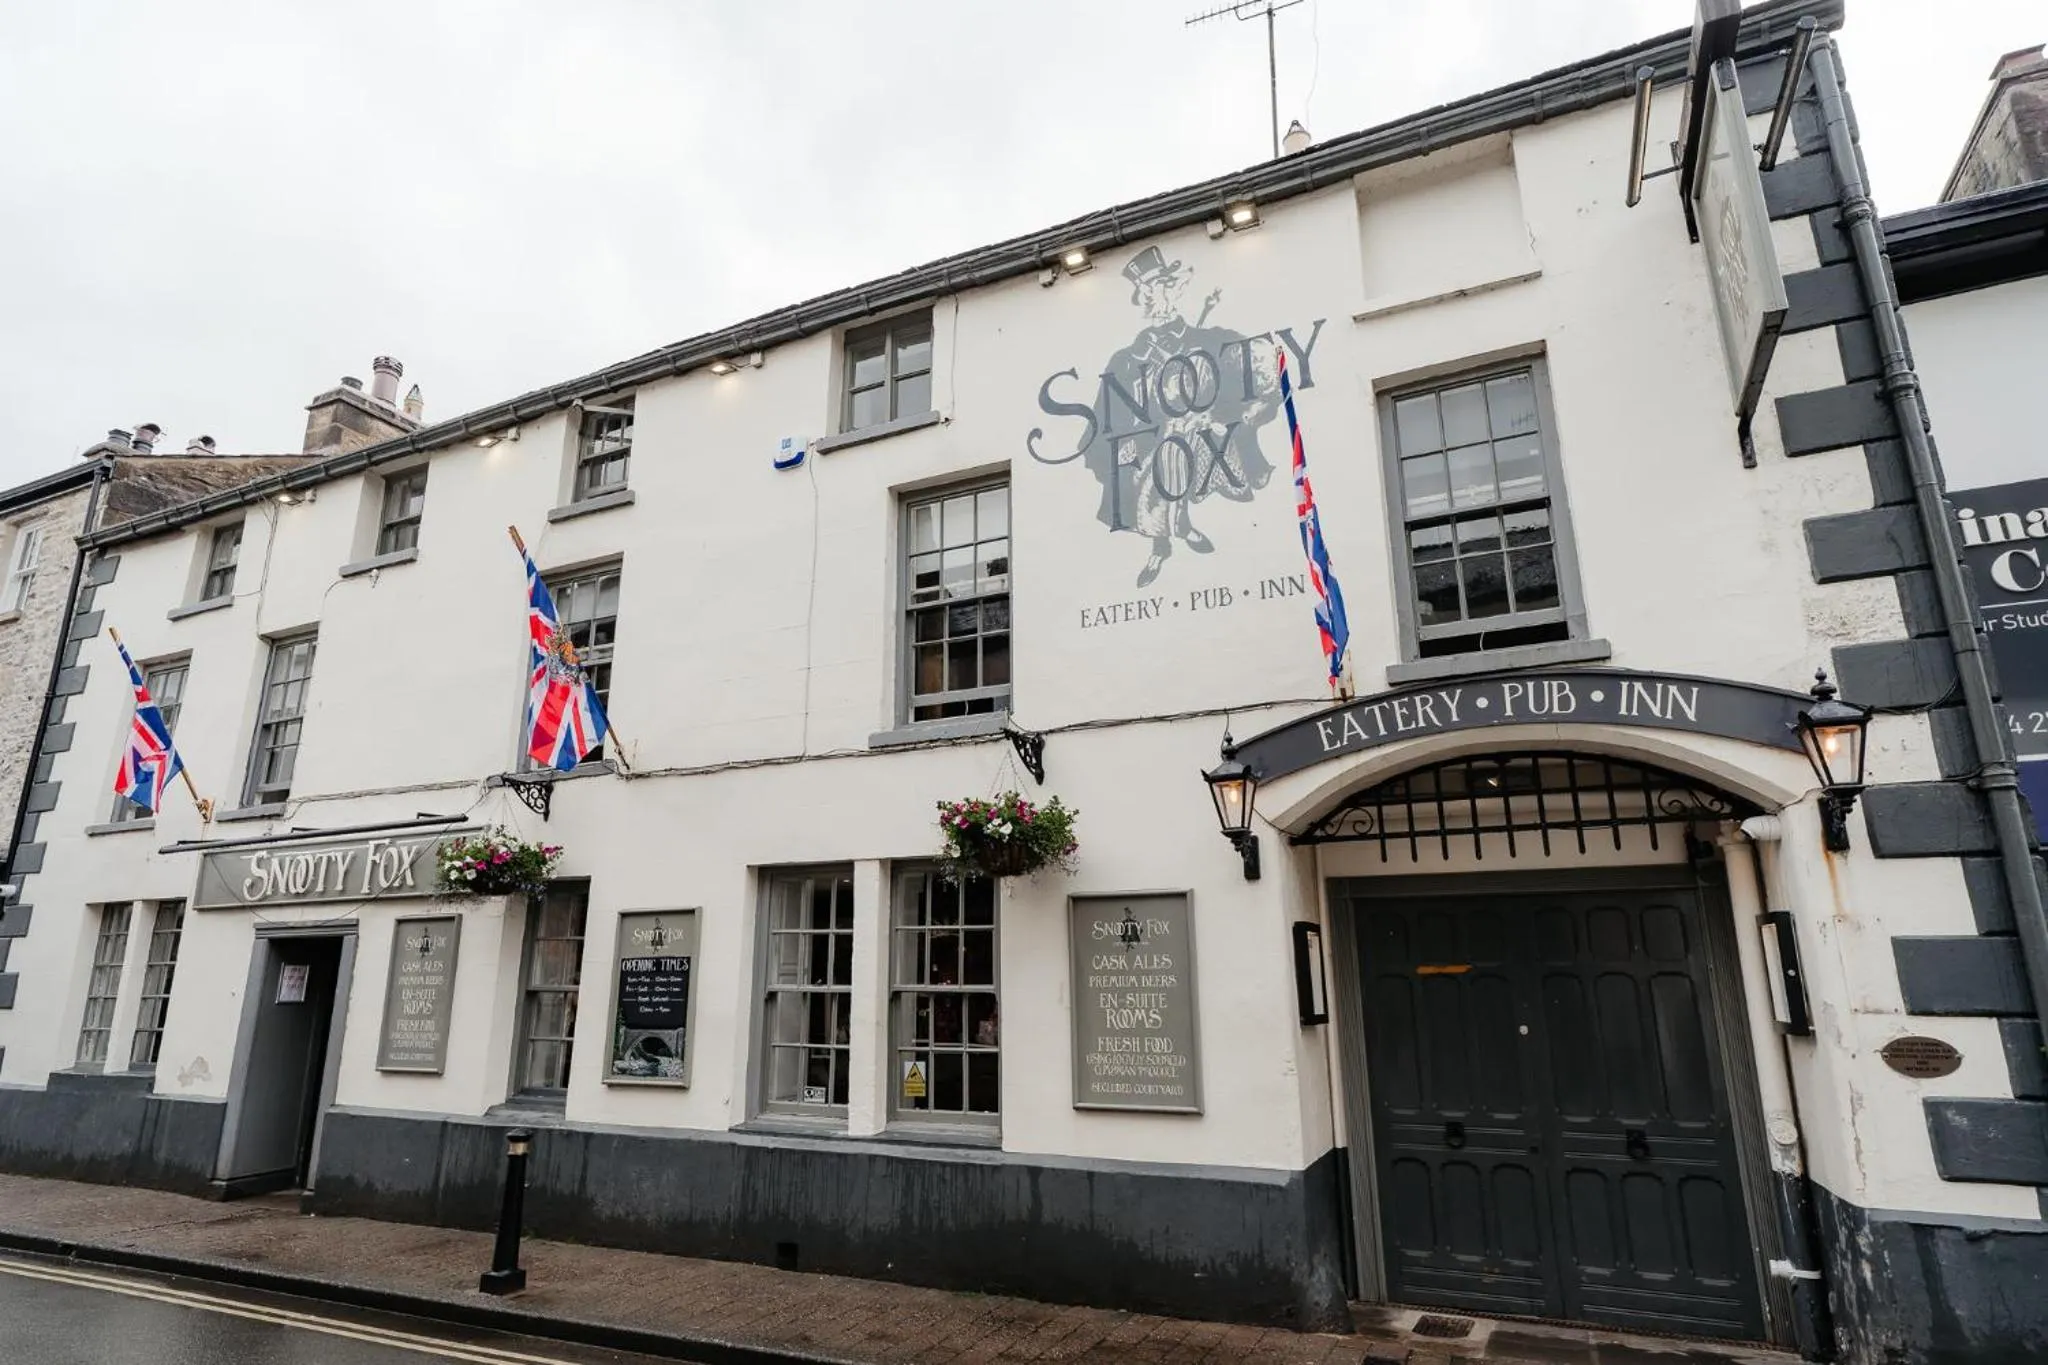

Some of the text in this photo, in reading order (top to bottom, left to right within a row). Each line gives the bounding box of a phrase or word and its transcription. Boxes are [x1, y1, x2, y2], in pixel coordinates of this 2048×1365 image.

[1027, 318, 1327, 464] SNOOTY
[1106, 421, 1248, 533] FOX
[1080, 574, 1307, 629] EATERY PUB INN
[1316, 680, 1700, 752] EATERY PUB INN
[243, 838, 418, 901] SNOOTY FOX
[1092, 918, 1170, 940] SNOOTY FOX
[622, 958, 689, 971] OPENING TIMES
[1092, 953, 1173, 970] CASK ALES
[1089, 975, 1138, 988] PREMIUM
[1106, 1008, 1163, 1030] ROOMS
[1098, 1036, 1174, 1053] FRESH FOOD
